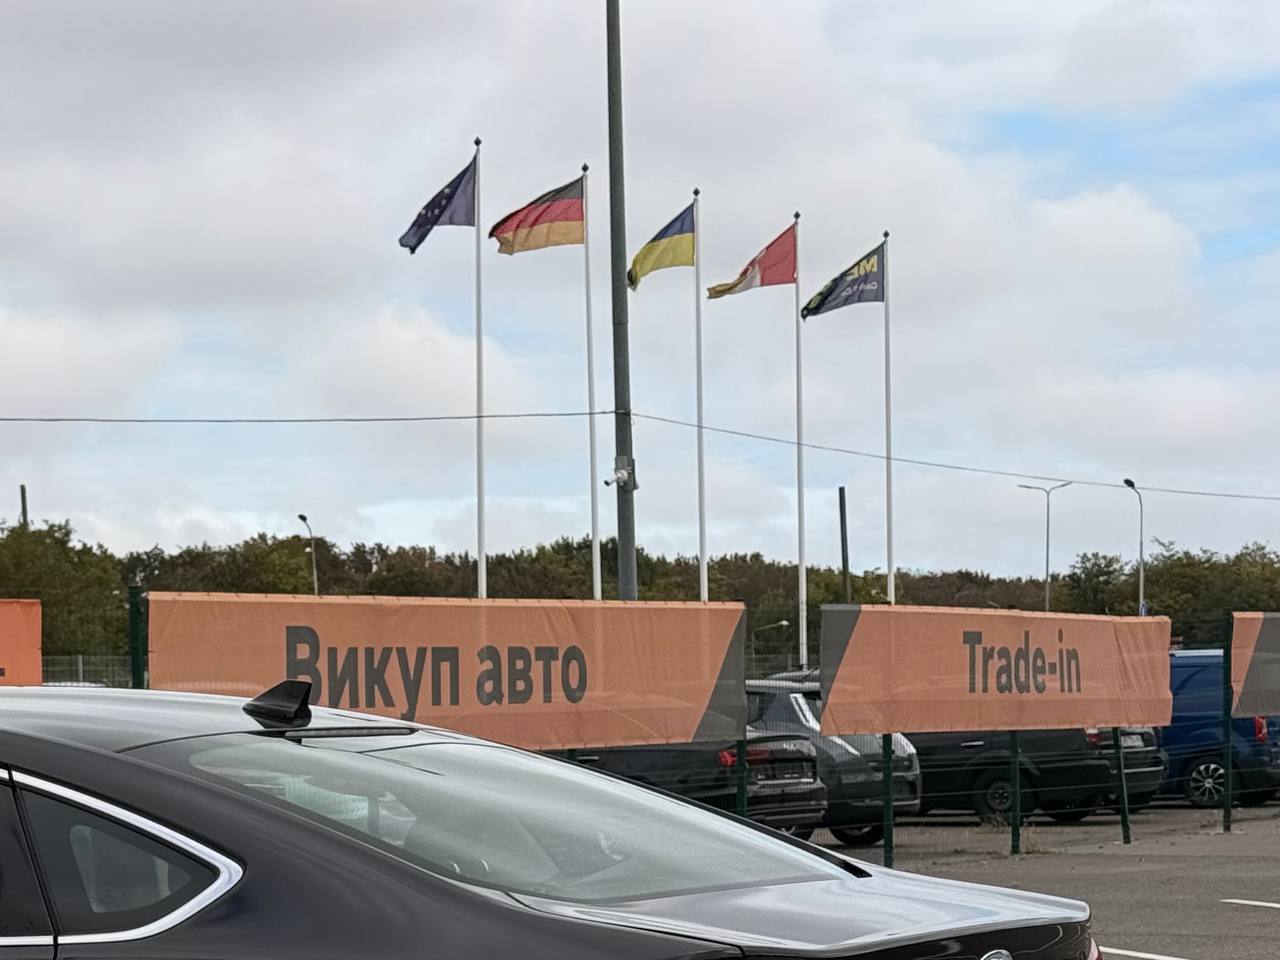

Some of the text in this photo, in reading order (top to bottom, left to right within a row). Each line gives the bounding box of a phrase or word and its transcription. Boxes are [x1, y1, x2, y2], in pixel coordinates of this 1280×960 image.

[285, 626, 587, 720] Викуп авто
[963, 629, 1082, 694] Trade-in
